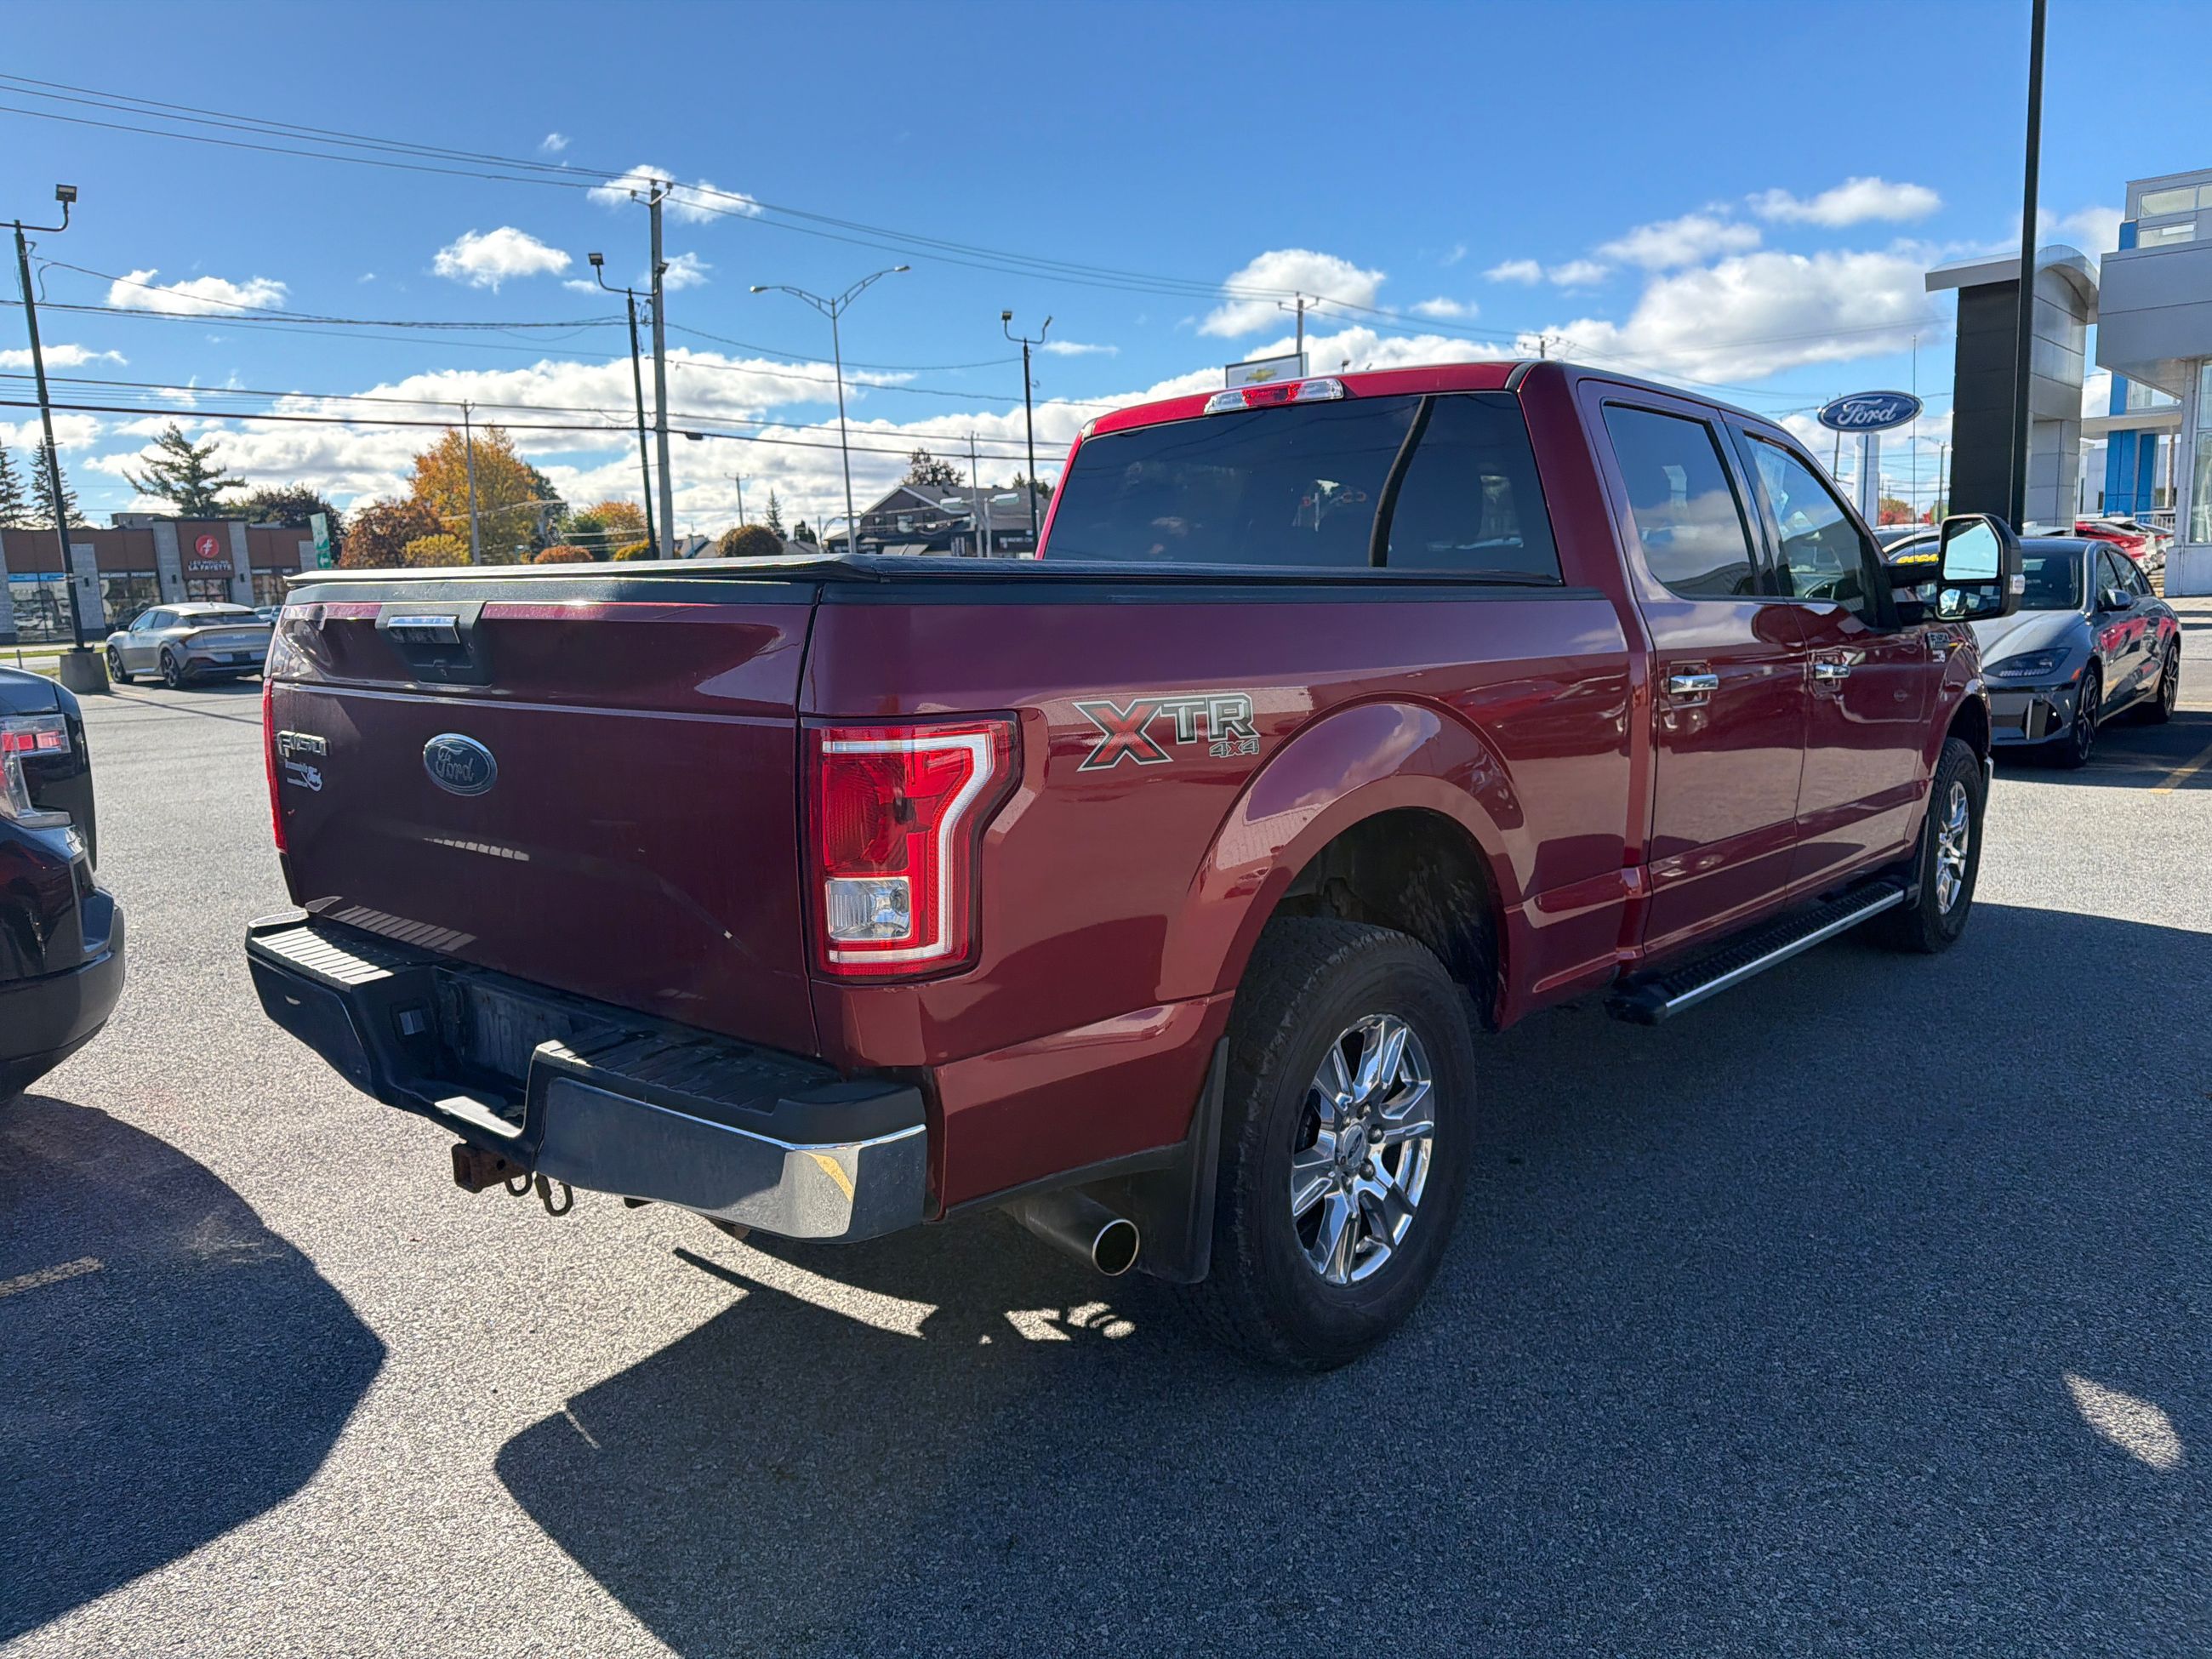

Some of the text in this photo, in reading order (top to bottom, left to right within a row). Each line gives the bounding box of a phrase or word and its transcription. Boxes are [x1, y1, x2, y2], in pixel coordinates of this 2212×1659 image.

[1838, 398, 1898, 425] Ford
[1072, 693, 1262, 772] XTR
[436, 745, 474, 782] Ford
